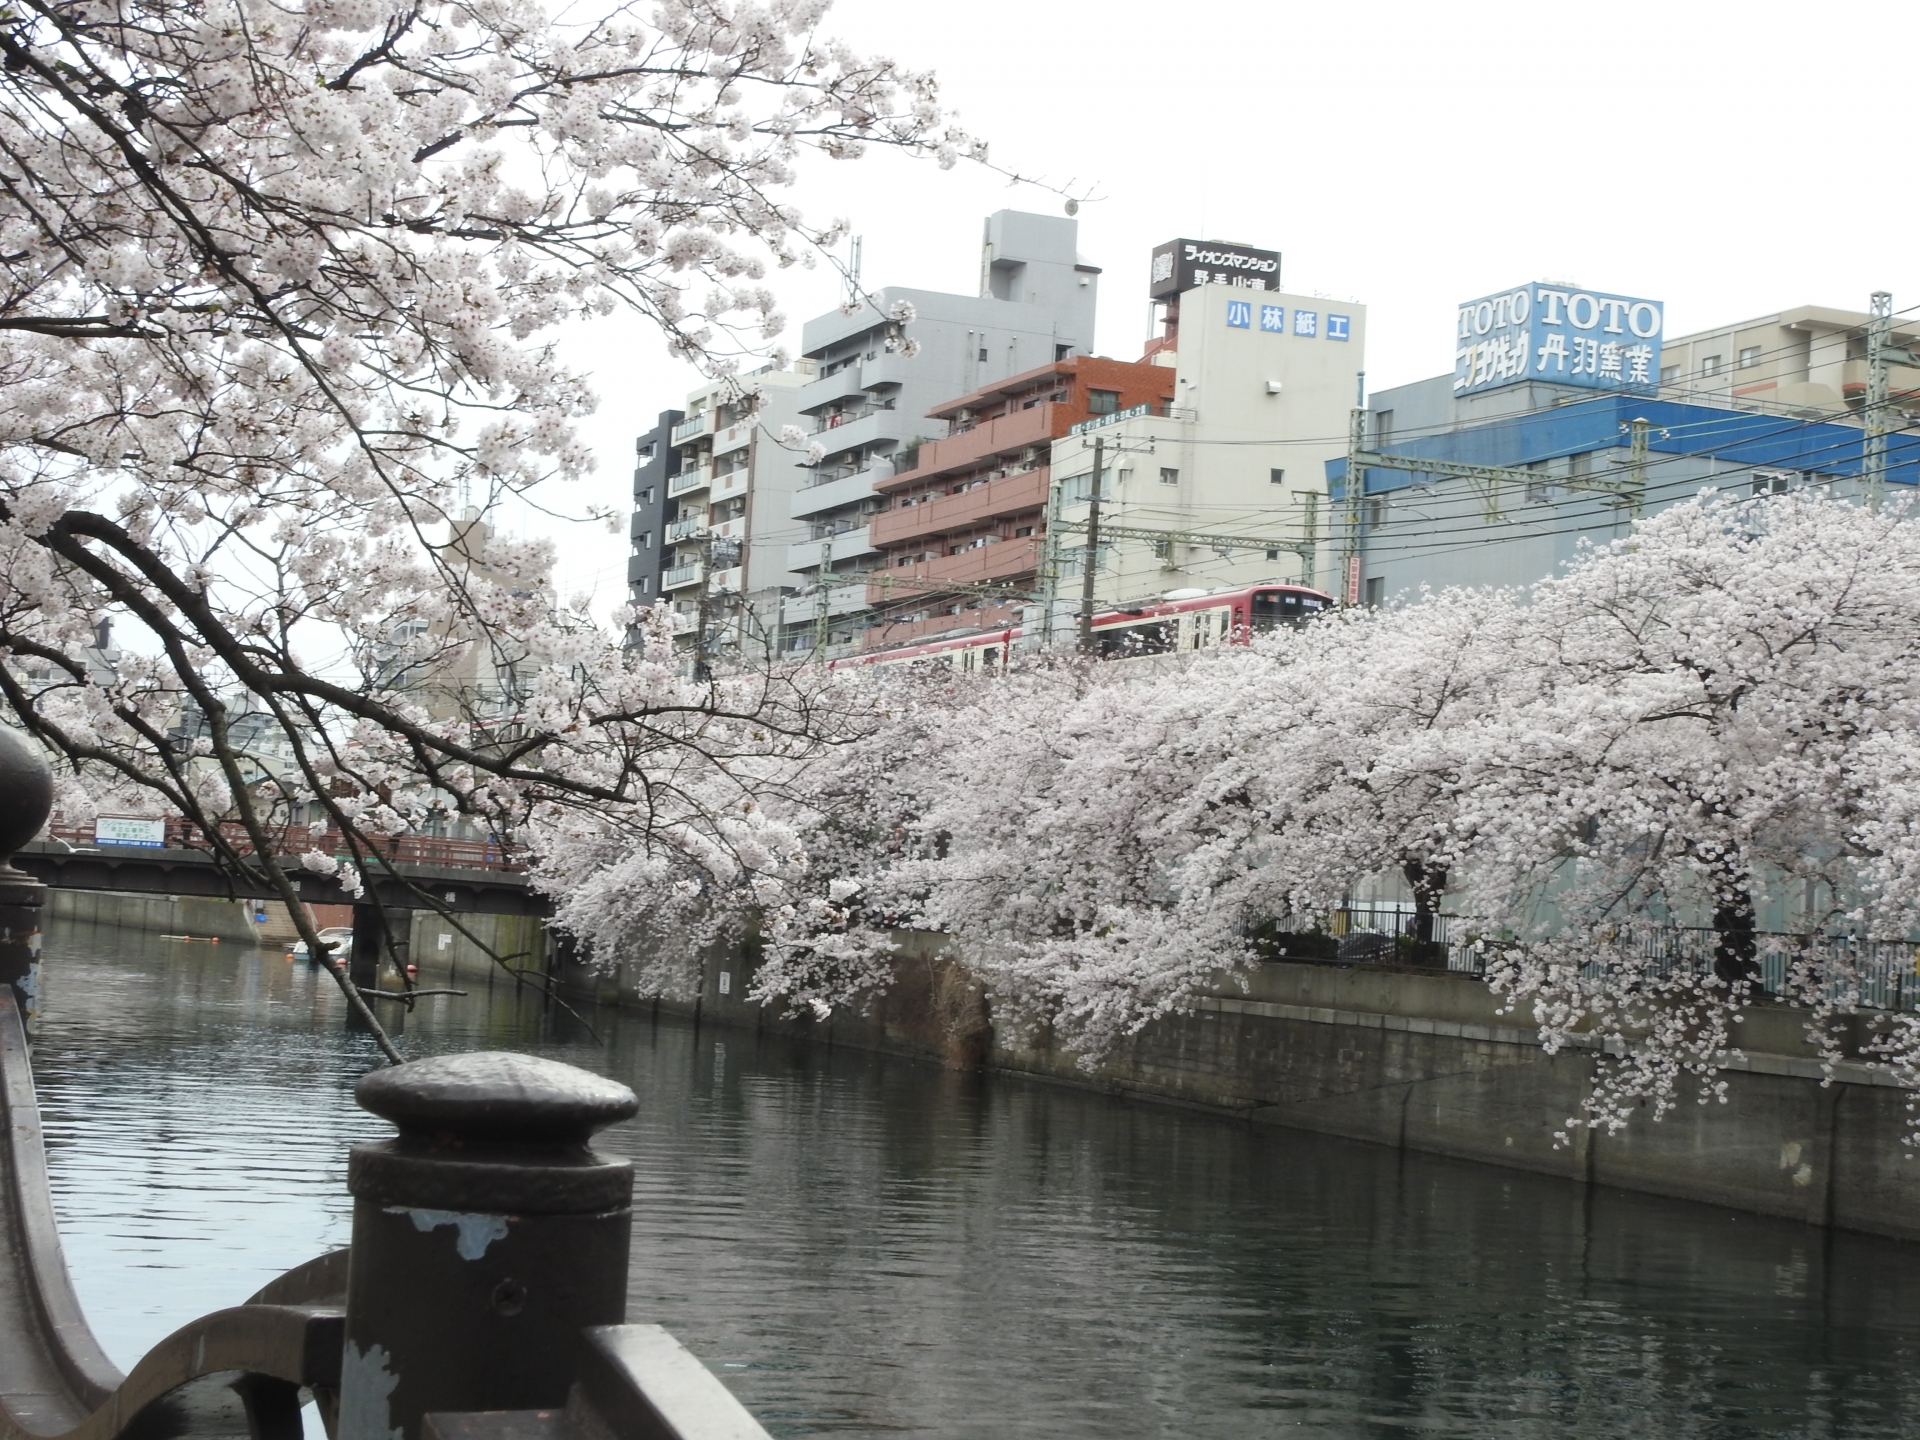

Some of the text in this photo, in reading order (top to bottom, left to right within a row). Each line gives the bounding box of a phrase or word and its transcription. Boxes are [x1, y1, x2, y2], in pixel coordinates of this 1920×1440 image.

[1185, 245, 1277, 272] ライオンズマンション
[1228, 303, 1348, 338] 小林紙工
[1458, 289, 1530, 339] TOTO
[1538, 289, 1661, 338] TOTO
[1536, 332, 1654, 384] 丹羽窯業
